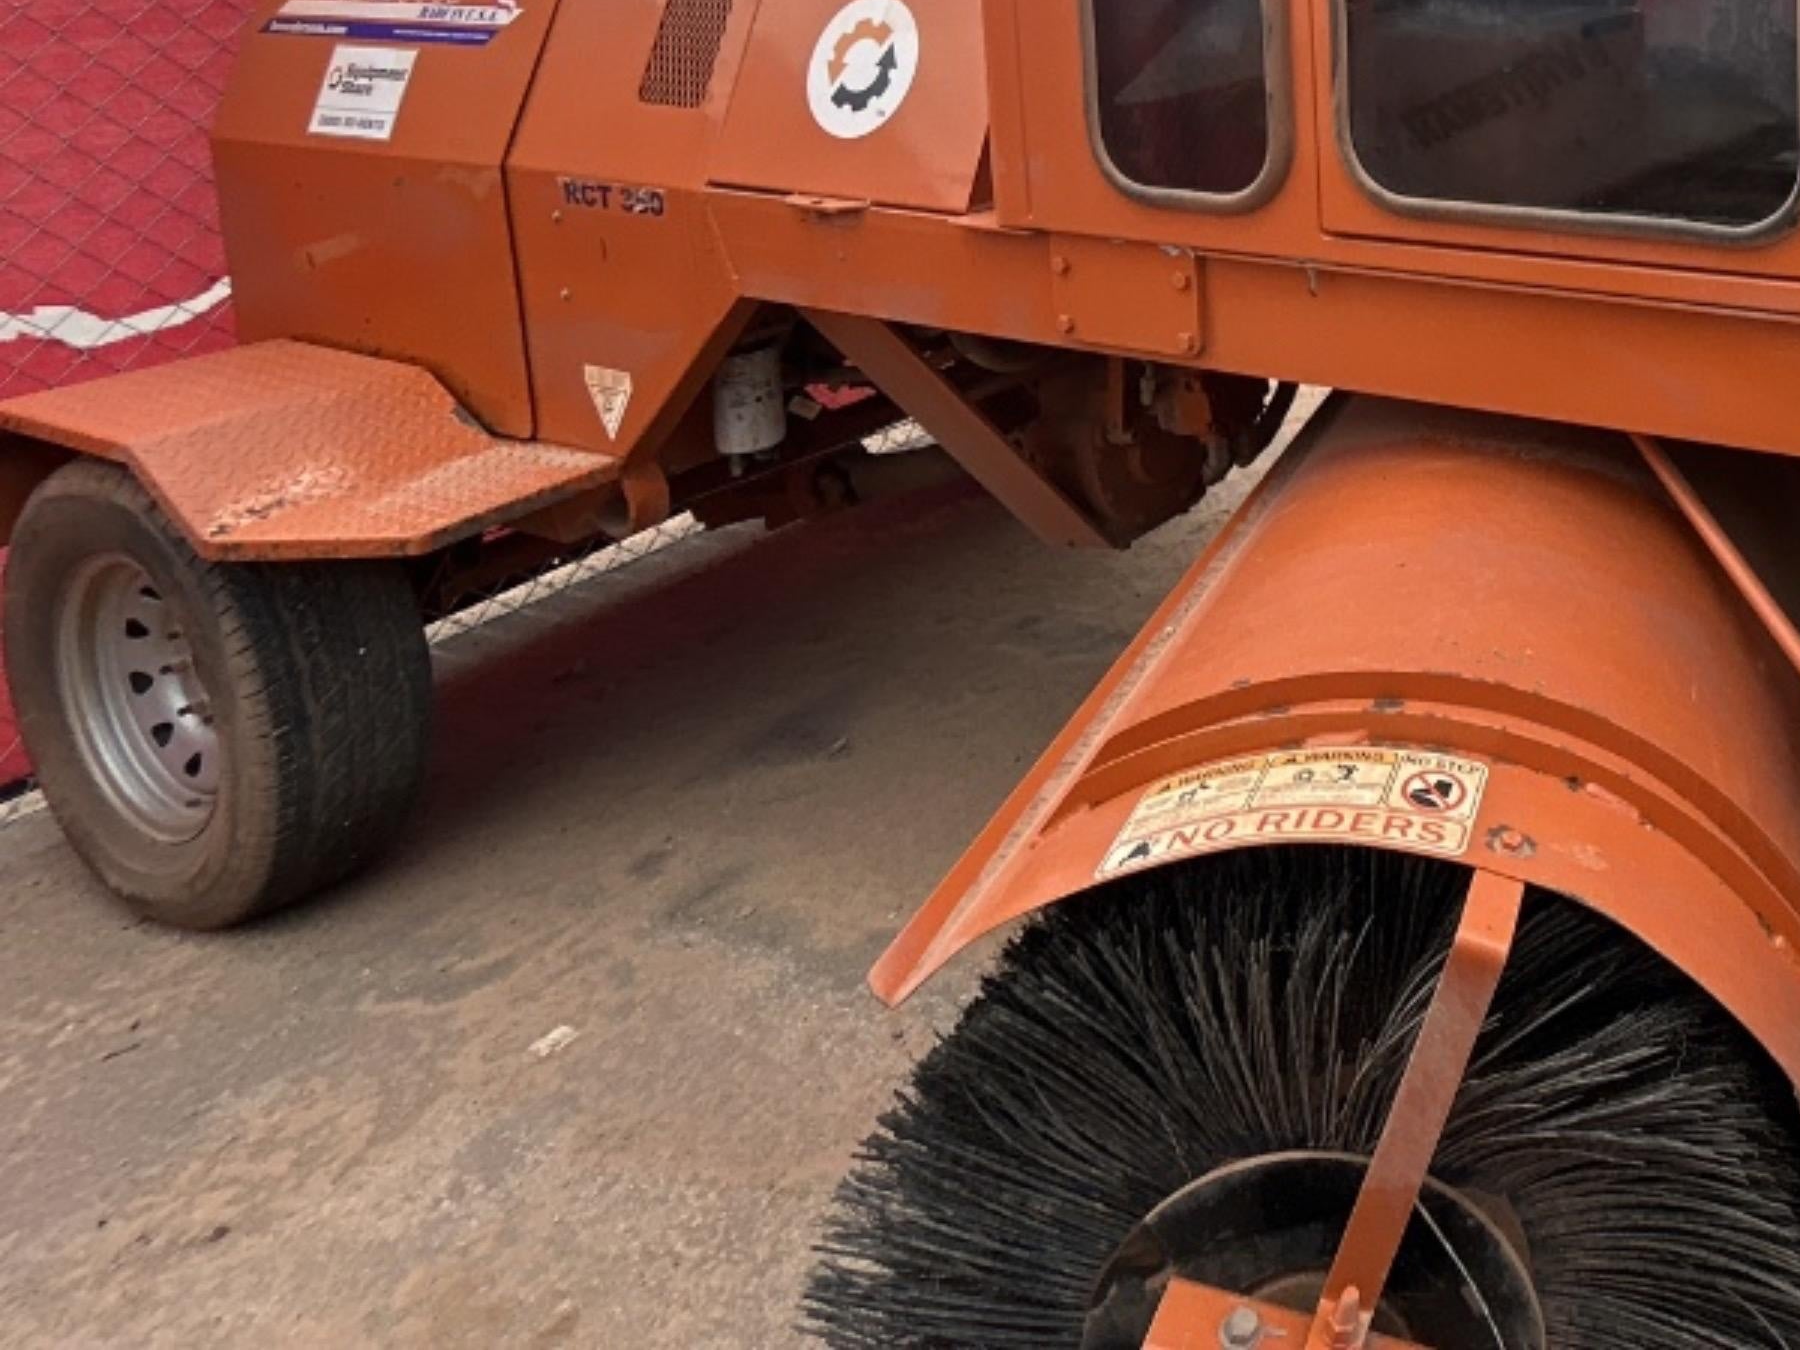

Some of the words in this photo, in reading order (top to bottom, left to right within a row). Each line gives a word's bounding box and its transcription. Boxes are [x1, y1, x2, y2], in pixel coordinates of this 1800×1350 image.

[563, 180, 613, 210] RCT
[1166, 818, 1236, 850] NO
[1256, 810, 1447, 845] RIDERS
